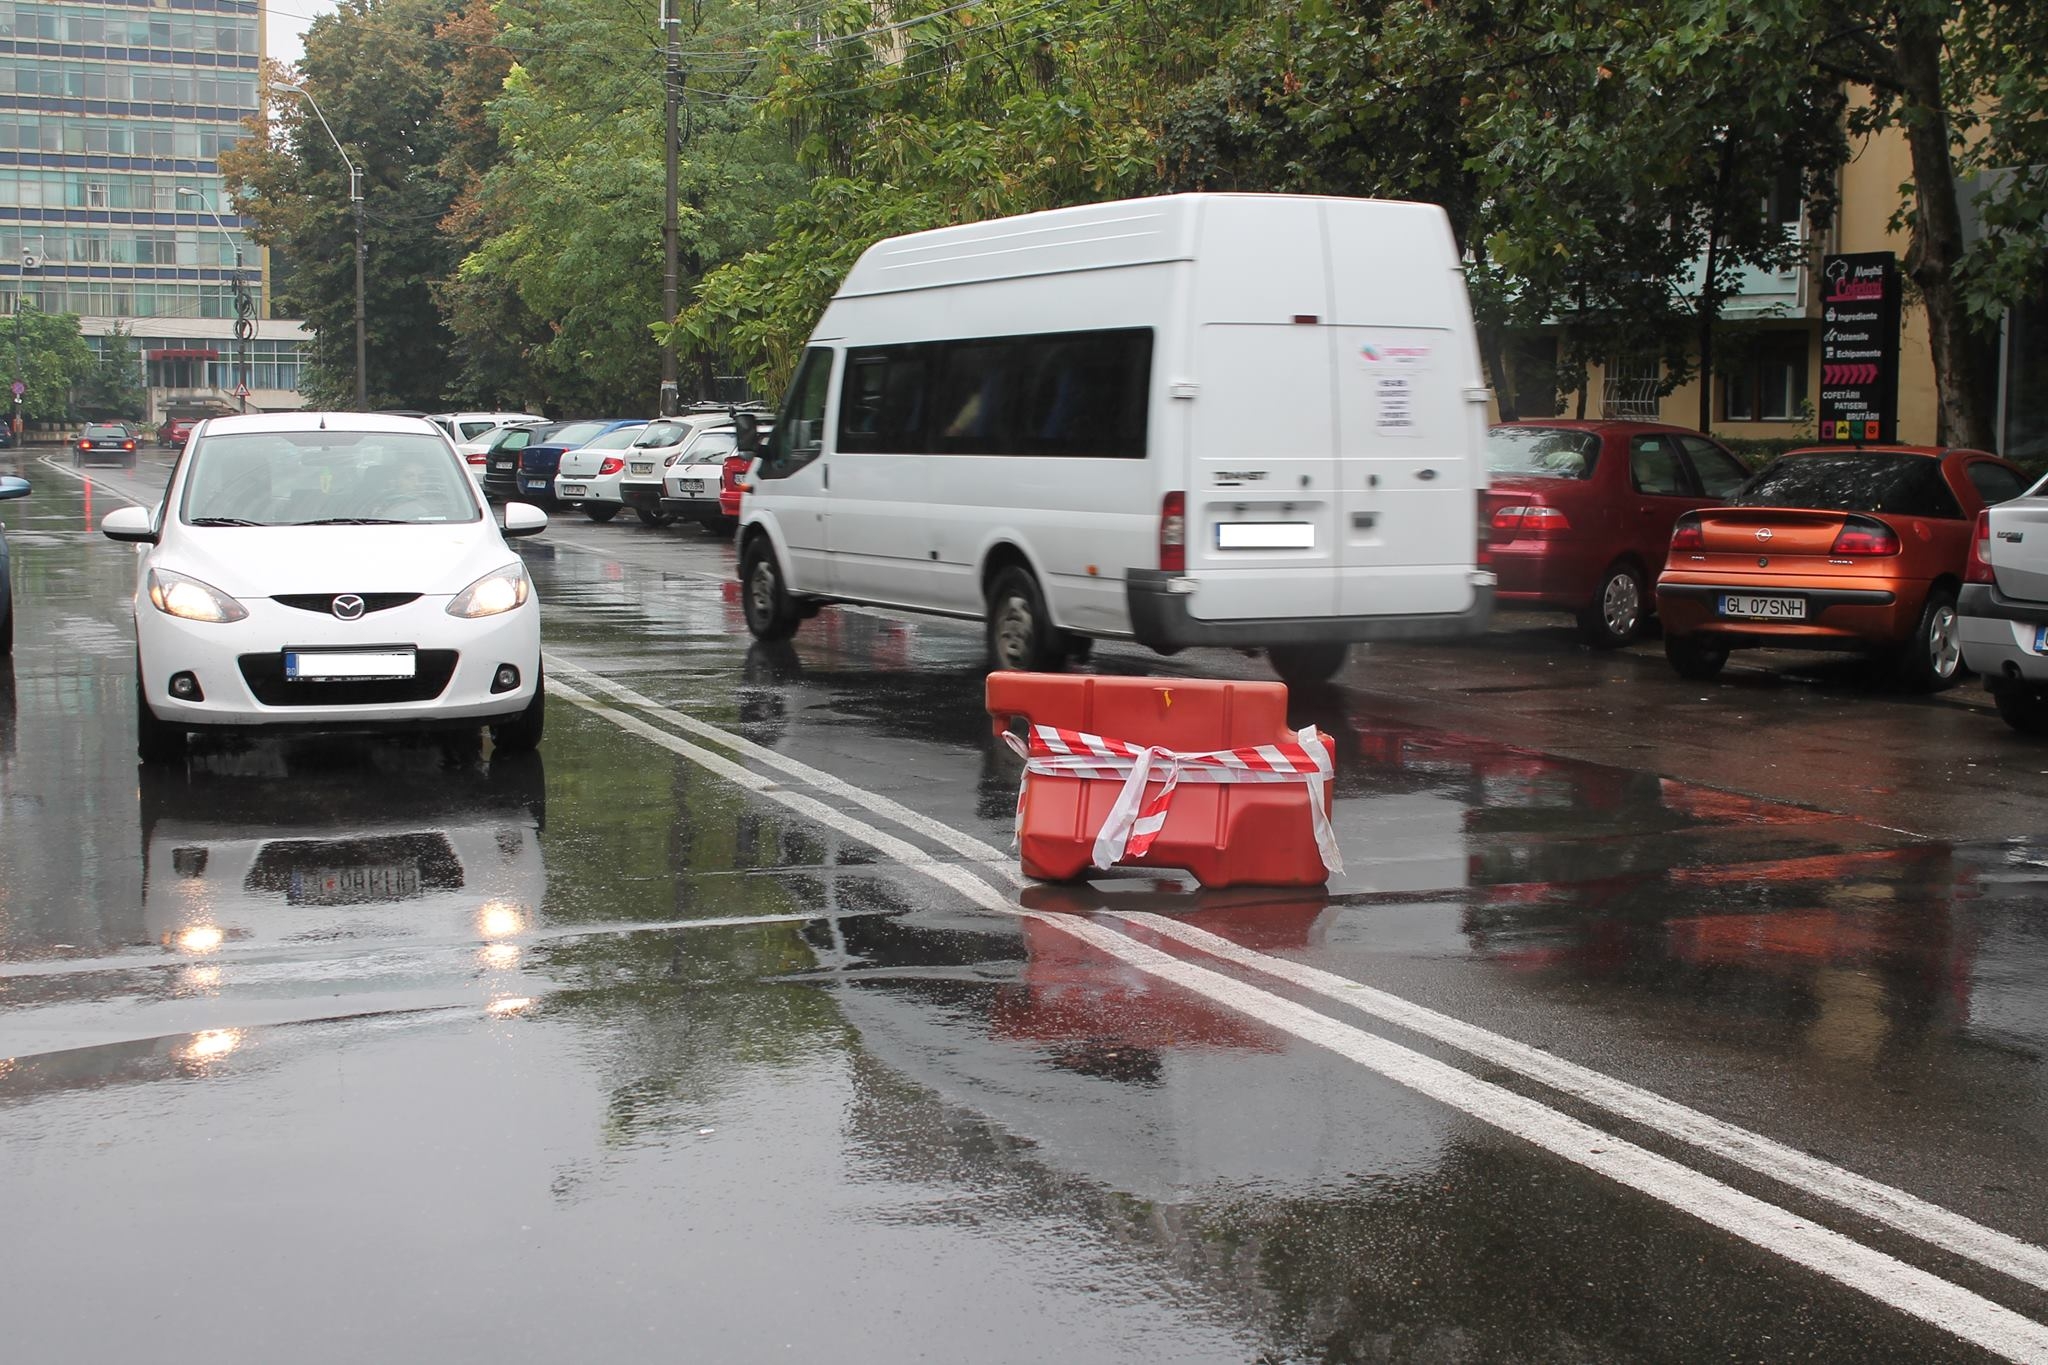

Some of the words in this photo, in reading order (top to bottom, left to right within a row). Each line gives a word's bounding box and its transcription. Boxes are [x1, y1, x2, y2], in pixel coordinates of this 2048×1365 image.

[1837, 312, 1878, 322] Ingrediente
[1837, 332, 1869, 341] Ustensile
[1836, 350, 1881, 359] Echipamente
[1726, 597, 1745, 613] GL
[1750, 598, 1768, 614] 07
[1769, 599, 1803, 616] SNH
[286, 668, 296, 676] RO
